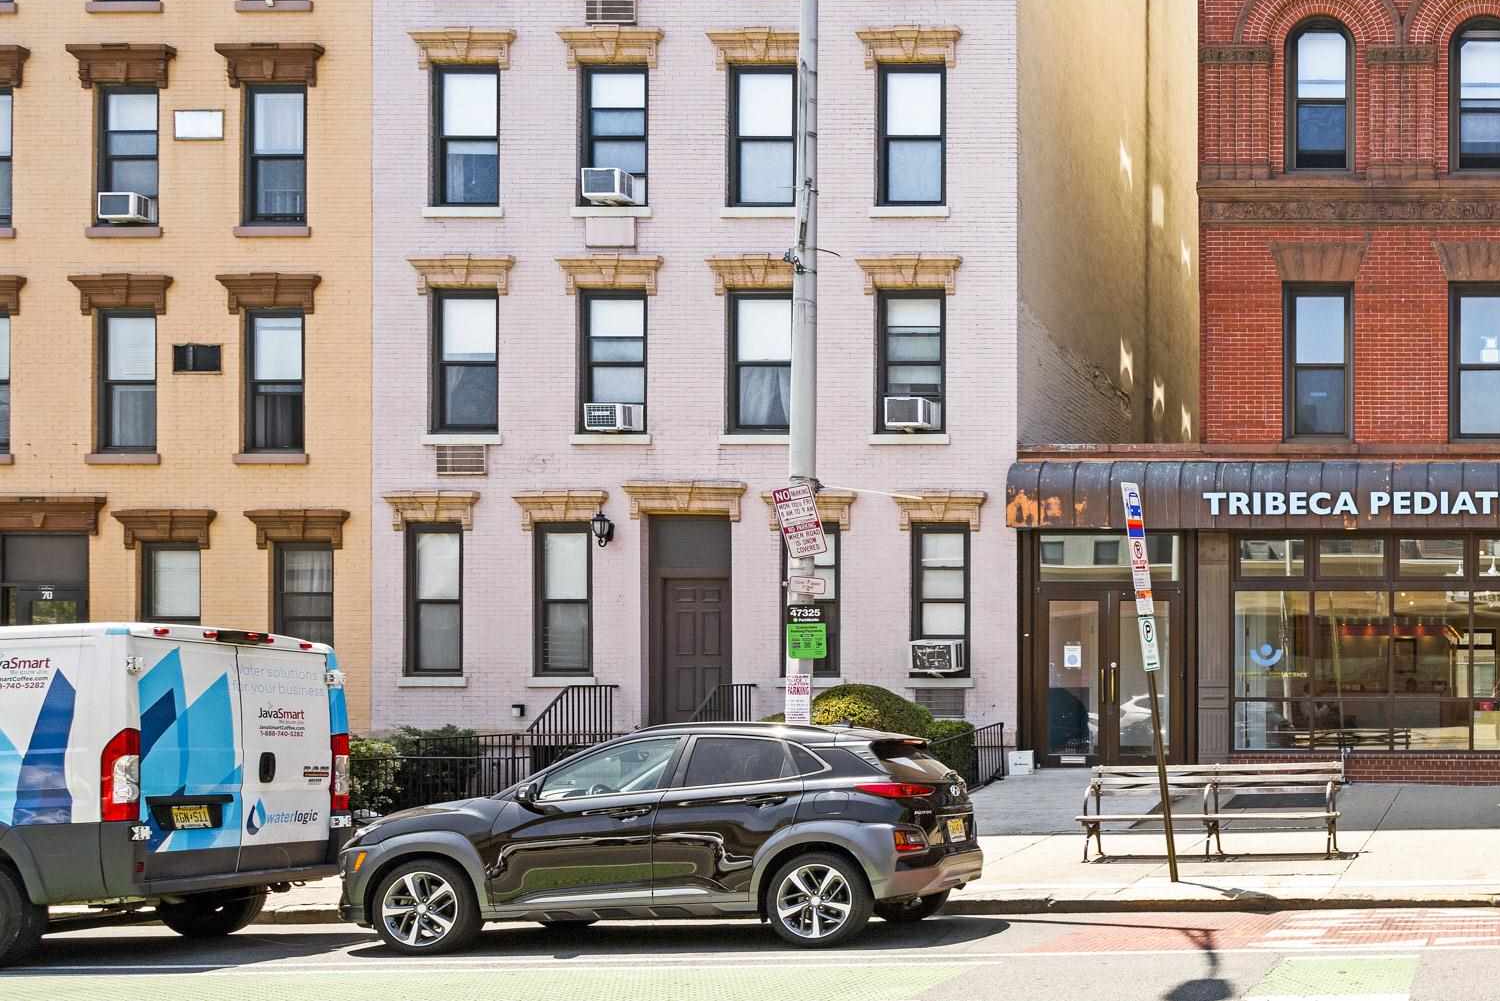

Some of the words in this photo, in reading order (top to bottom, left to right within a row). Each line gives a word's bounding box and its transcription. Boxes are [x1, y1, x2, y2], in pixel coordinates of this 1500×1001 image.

[774, 490, 790, 502] NO
[1202, 491, 1360, 516] TRIBECA
[788, 531, 804, 540] WHEN
[805, 529, 820, 537] ROAD
[41, 591, 53, 600] 70
[790, 608, 821, 617] 47325
[787, 686, 809, 695] PARKING
[258, 707, 305, 720] JavaSmart
[266, 810, 318, 824] waterlogic
